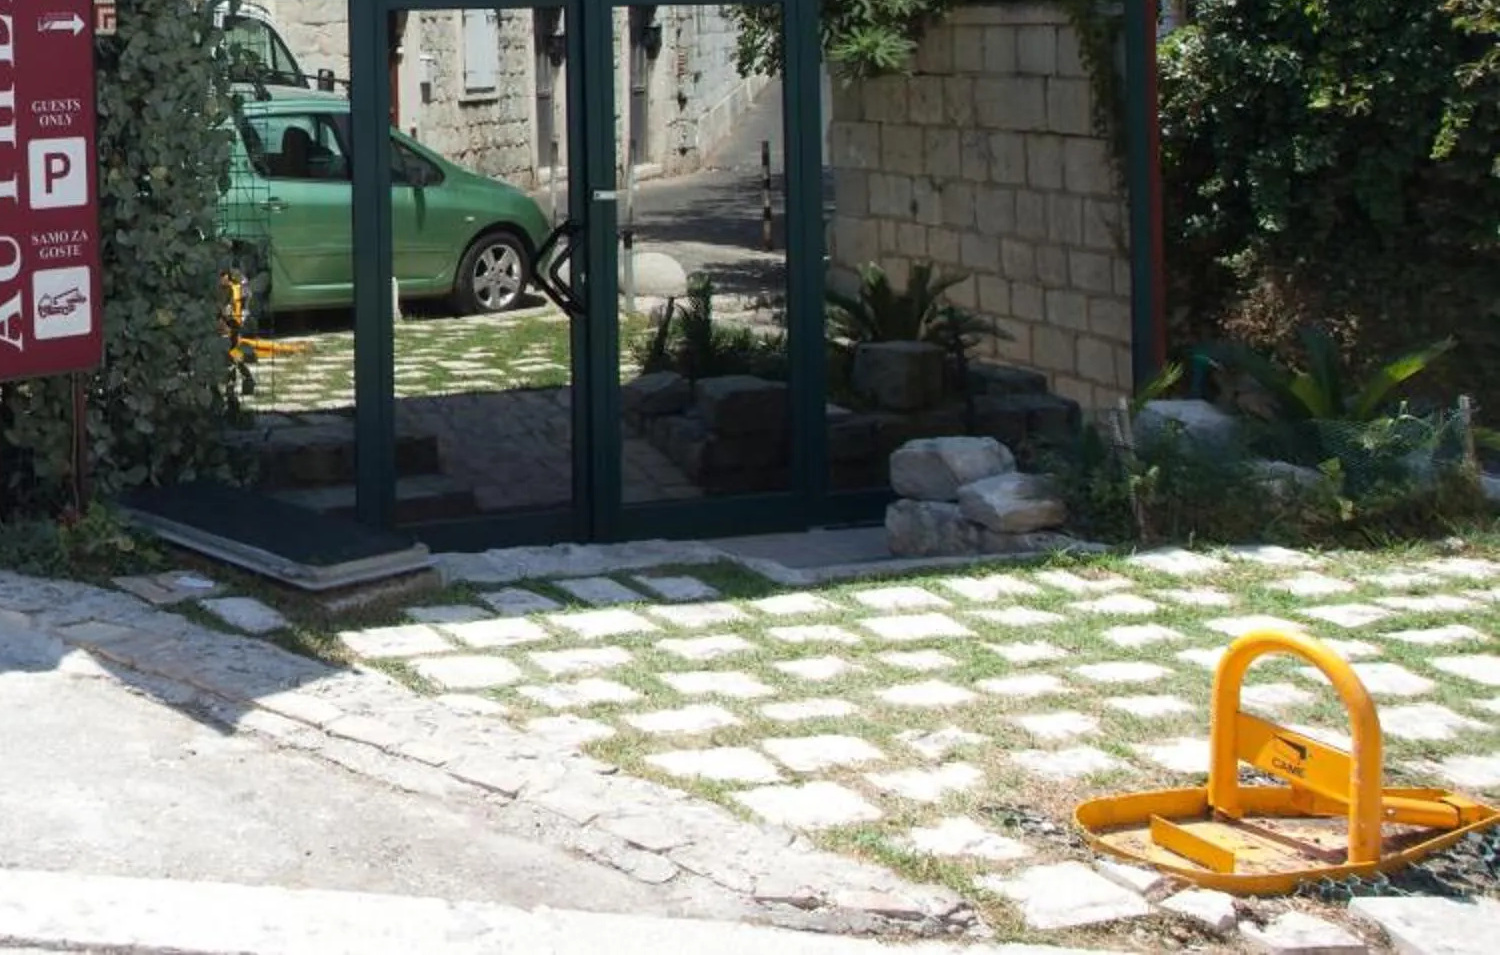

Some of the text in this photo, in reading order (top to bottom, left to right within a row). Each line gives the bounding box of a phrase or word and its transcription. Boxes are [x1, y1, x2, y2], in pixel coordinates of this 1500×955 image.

[31, 99, 81, 114] GUESTS
[38, 113, 73, 127] ONLY
[44, 152, 71, 194] P
[31, 229, 88, 245] SAMO ZA
[38, 244, 82, 260] GOSTE
